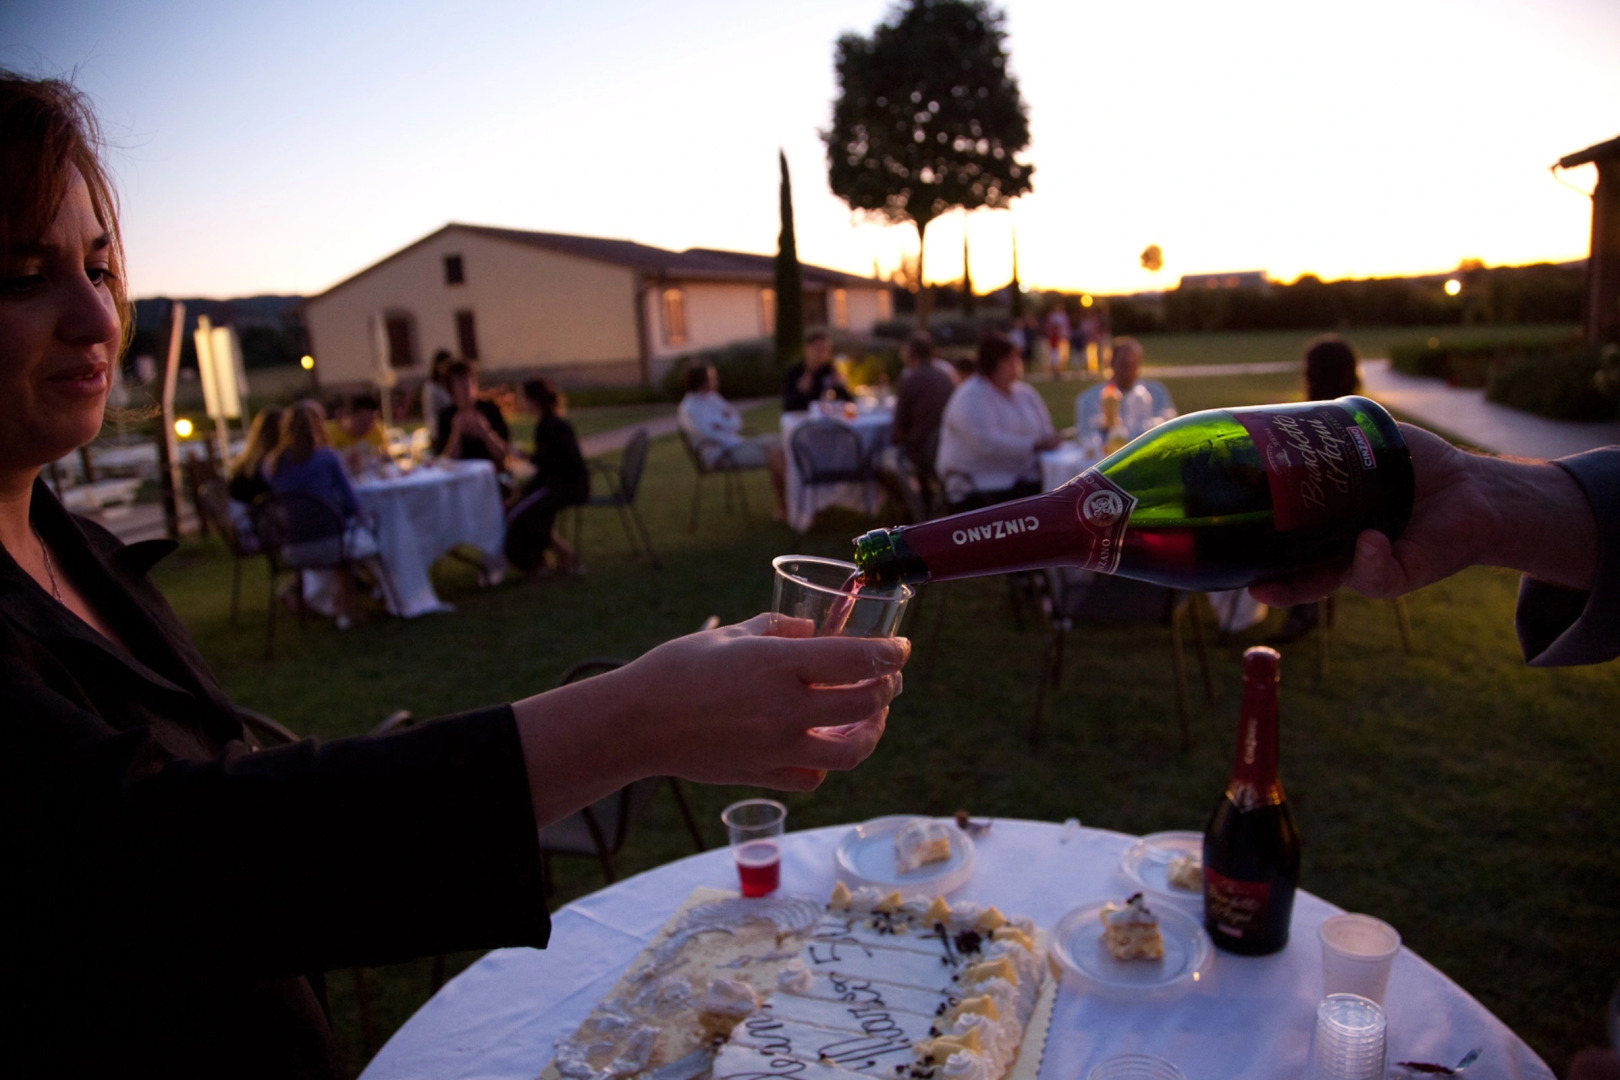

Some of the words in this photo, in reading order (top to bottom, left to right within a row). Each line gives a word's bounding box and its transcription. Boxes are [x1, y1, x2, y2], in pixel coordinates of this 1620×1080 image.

[1272, 414, 1326, 508] Brachetto
[1351, 428, 1373, 467] CINZANO
[952, 515, 1039, 545] CINZANO
